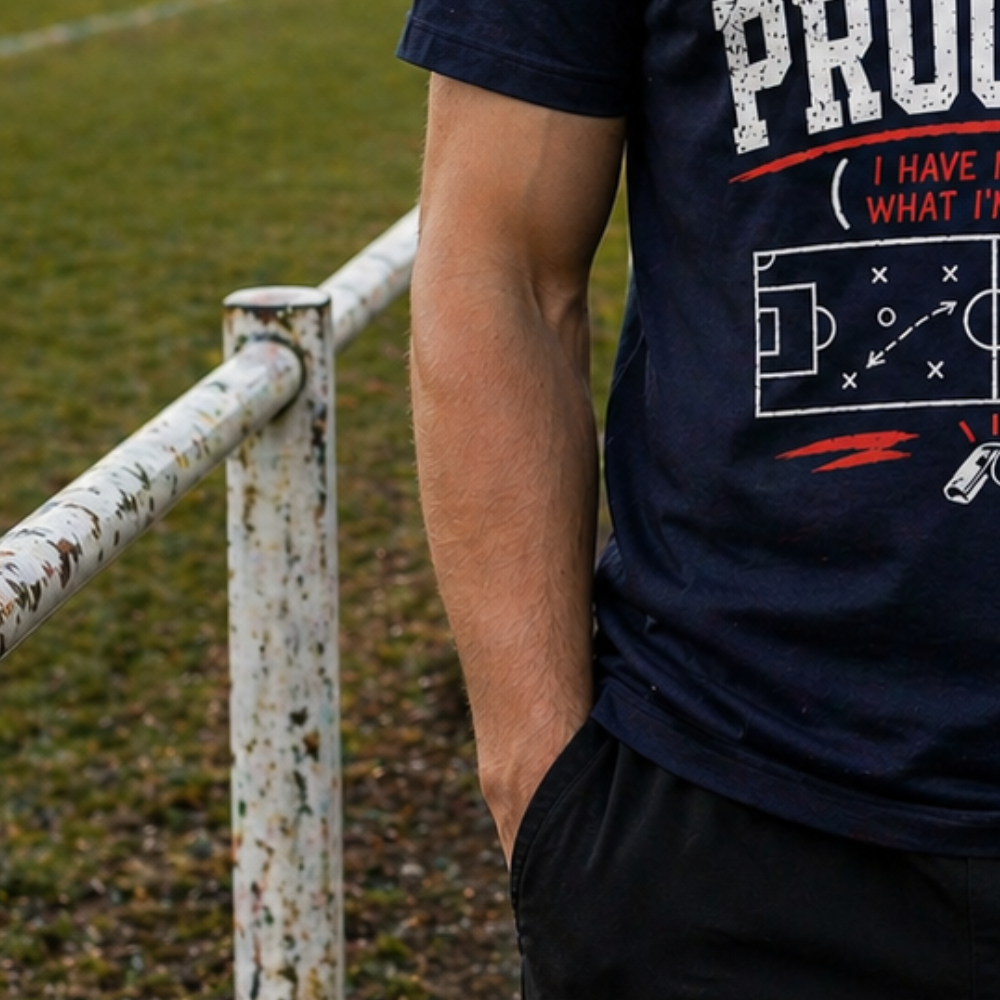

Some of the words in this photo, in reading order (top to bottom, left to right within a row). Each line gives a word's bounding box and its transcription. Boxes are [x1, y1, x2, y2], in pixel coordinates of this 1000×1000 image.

[873, 156, 882, 185] I
[899, 151, 976, 182] HAVE
[867, 190, 955, 224] WHAT
